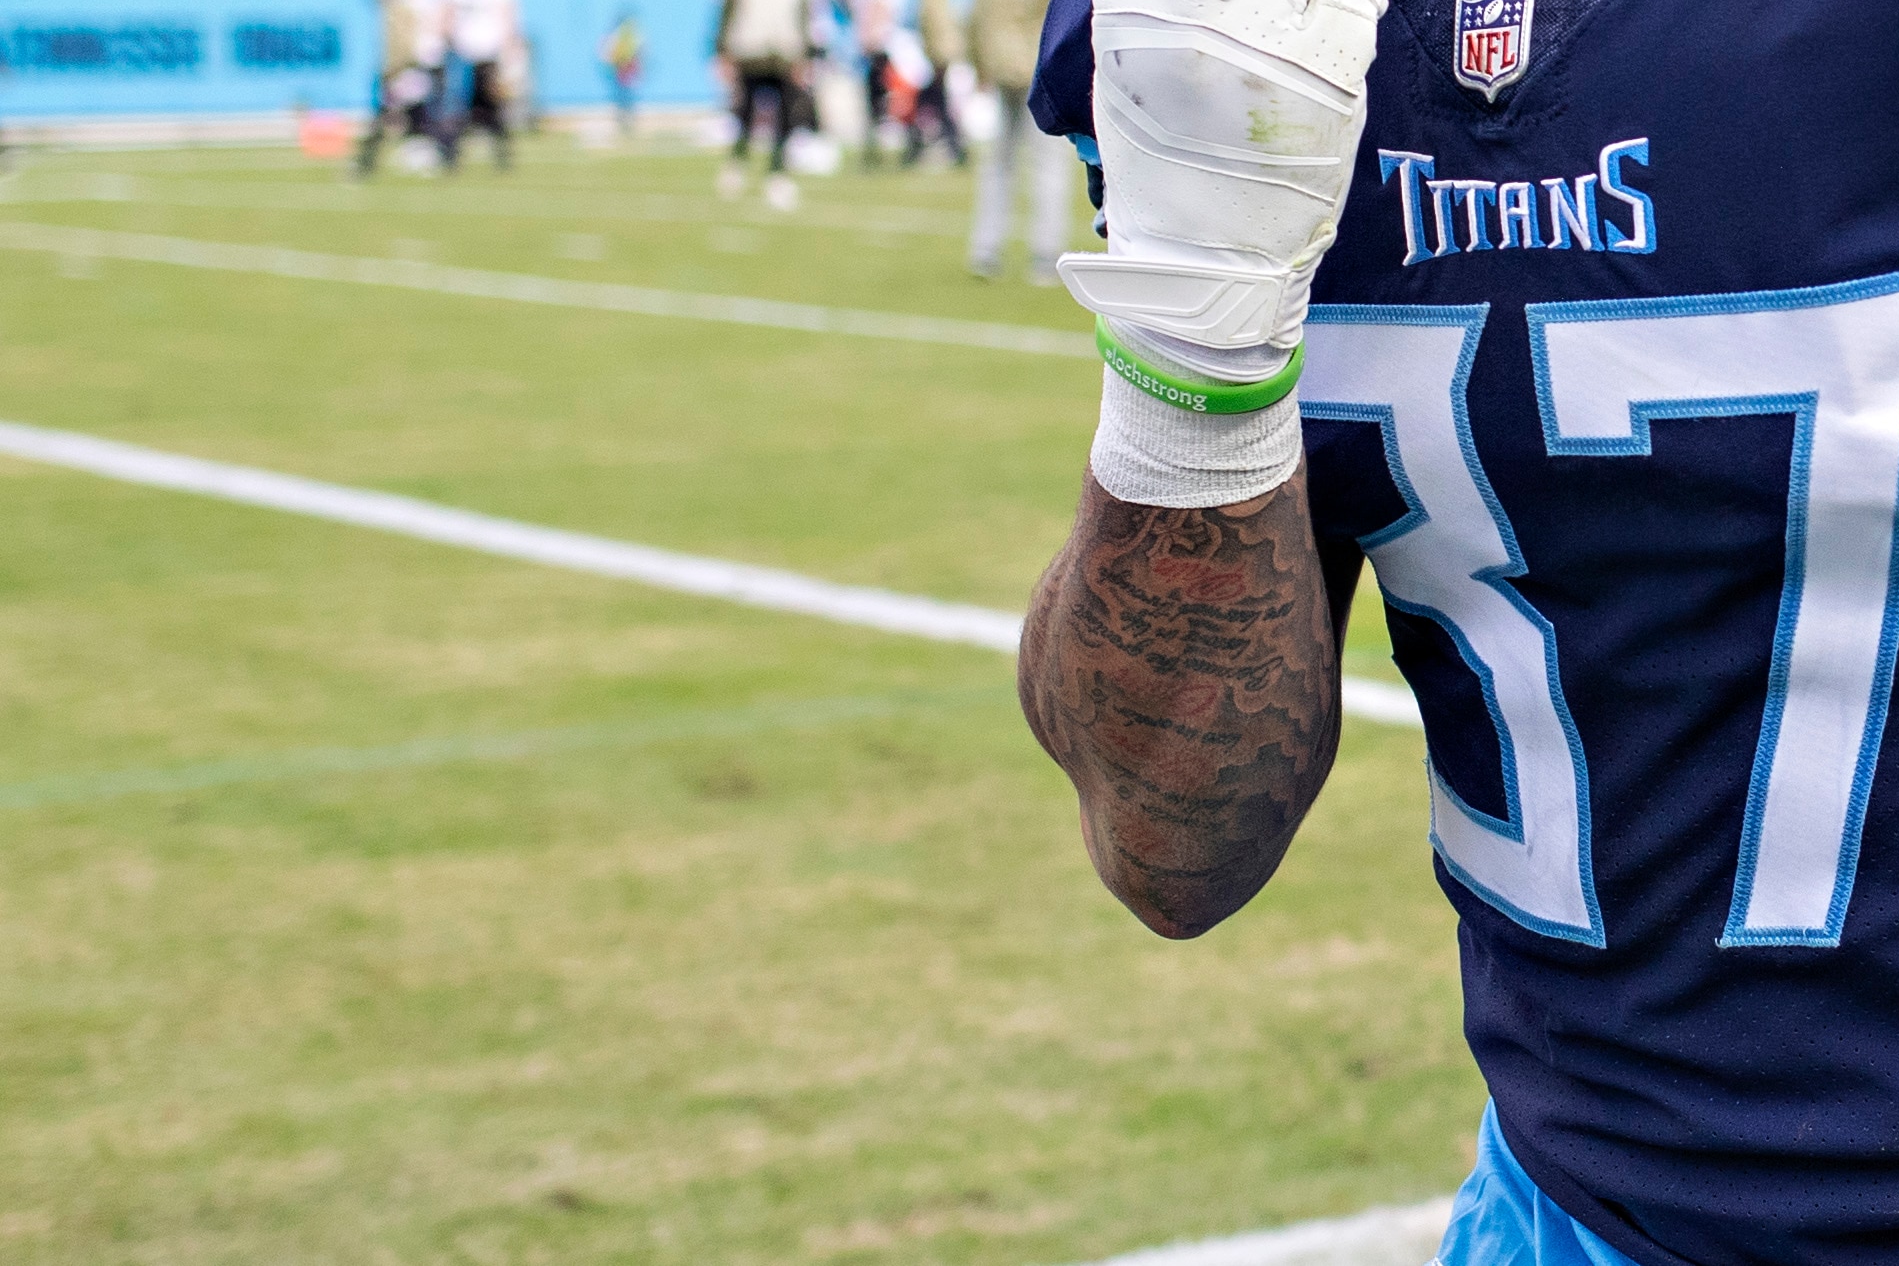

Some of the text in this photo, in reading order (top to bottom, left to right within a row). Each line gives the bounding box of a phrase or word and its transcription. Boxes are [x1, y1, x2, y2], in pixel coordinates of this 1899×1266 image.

[1464, 30, 1515, 77] NFL
[1377, 137, 1658, 267] TITANS
[1105, 346, 1208, 413] #lochstrong
